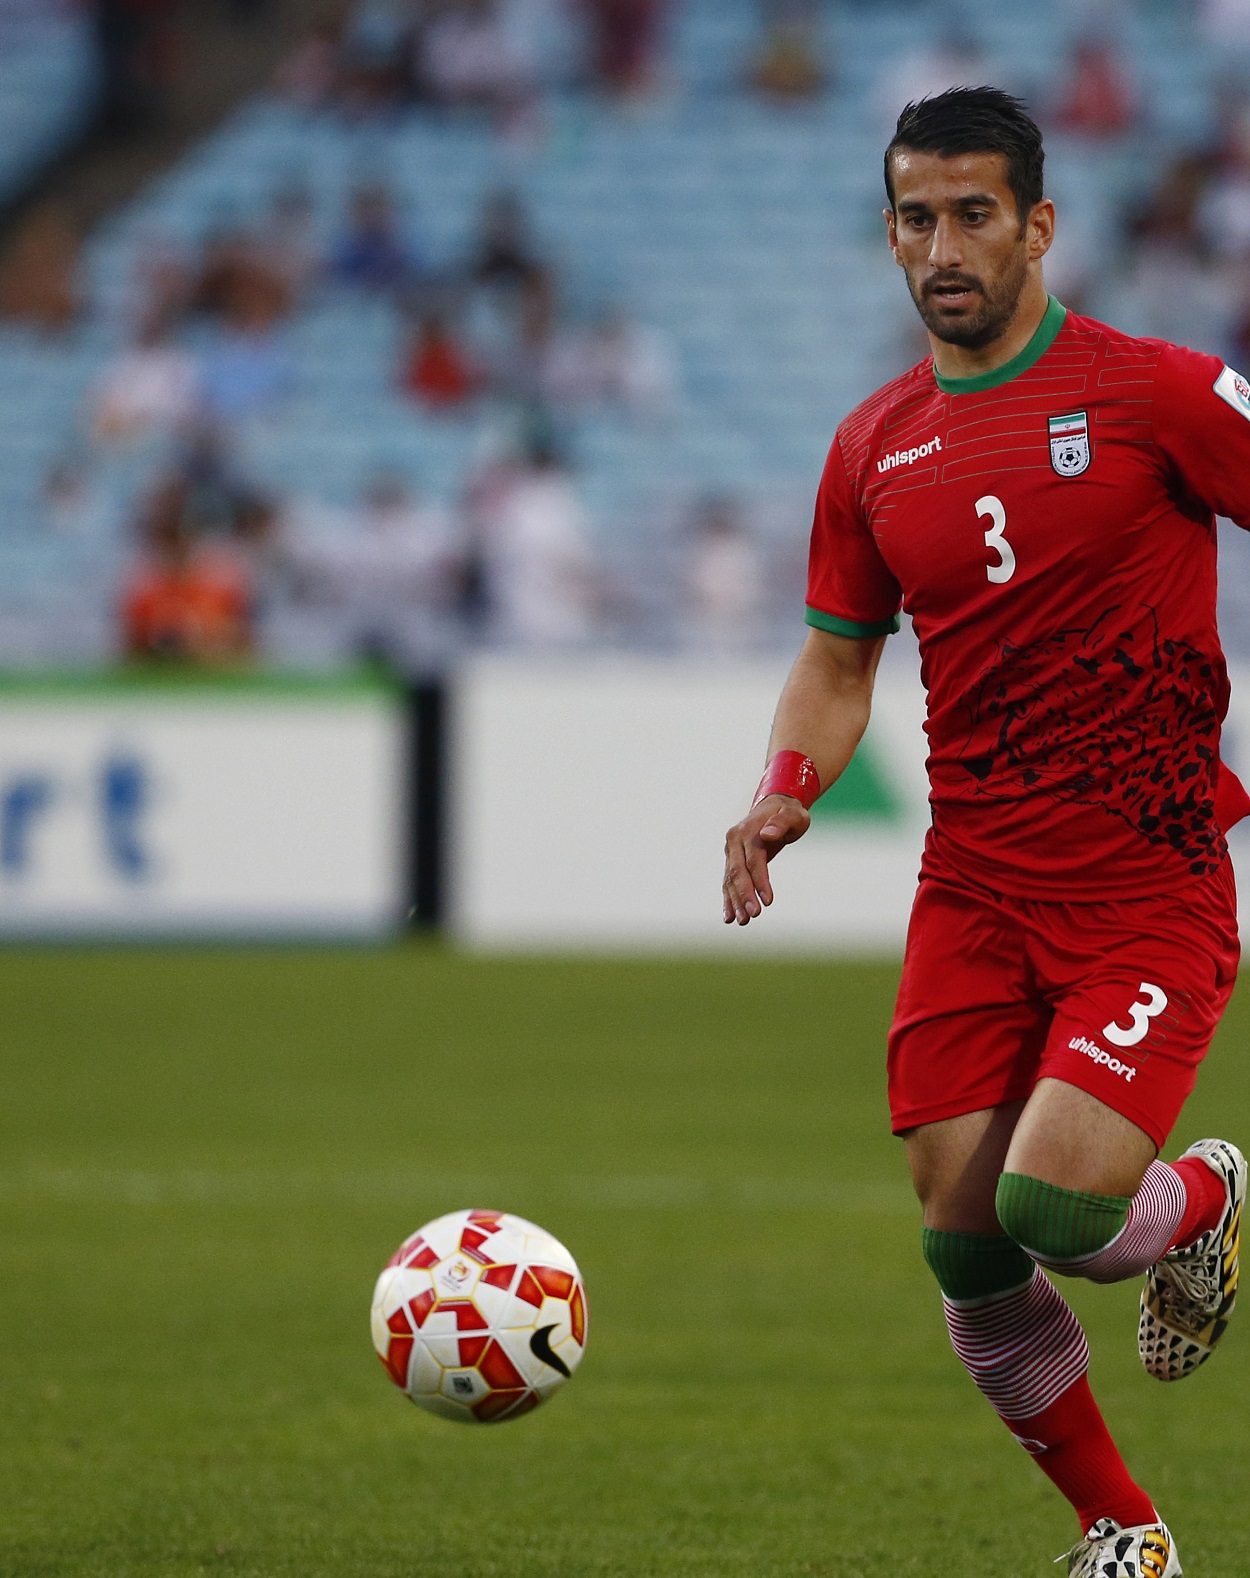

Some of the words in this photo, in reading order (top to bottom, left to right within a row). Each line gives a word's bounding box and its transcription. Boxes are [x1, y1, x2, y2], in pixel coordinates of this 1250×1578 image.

[877, 435, 943, 473] uhlsport
[974, 495, 1017, 584] 3
[1102, 982, 1168, 1047] 3
[1068, 1036, 1137, 1083] uhlsport
